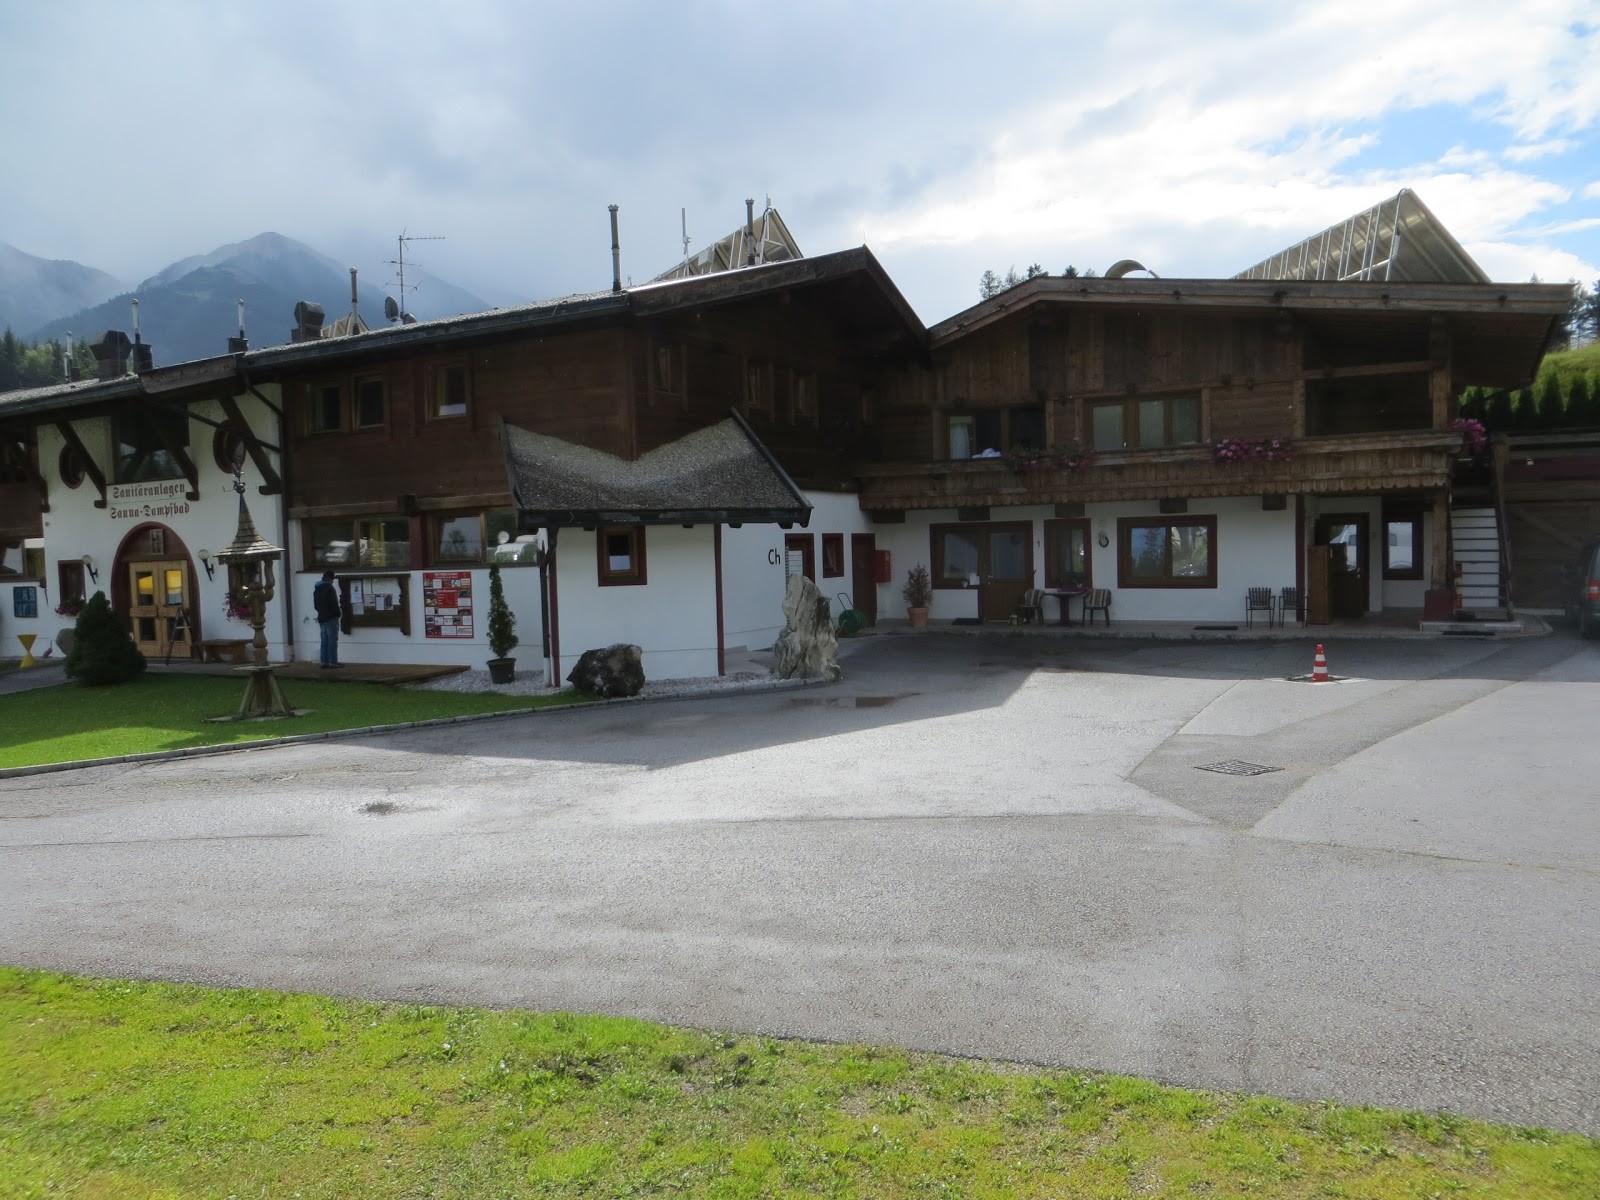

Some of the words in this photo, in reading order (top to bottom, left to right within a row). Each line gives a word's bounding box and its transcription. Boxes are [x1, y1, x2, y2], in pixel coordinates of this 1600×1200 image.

[113, 483, 185, 499] Sanitäranlagen
[110, 502, 190, 519] Sauna-Dampfbad
[768, 548, 780, 565] Ch
